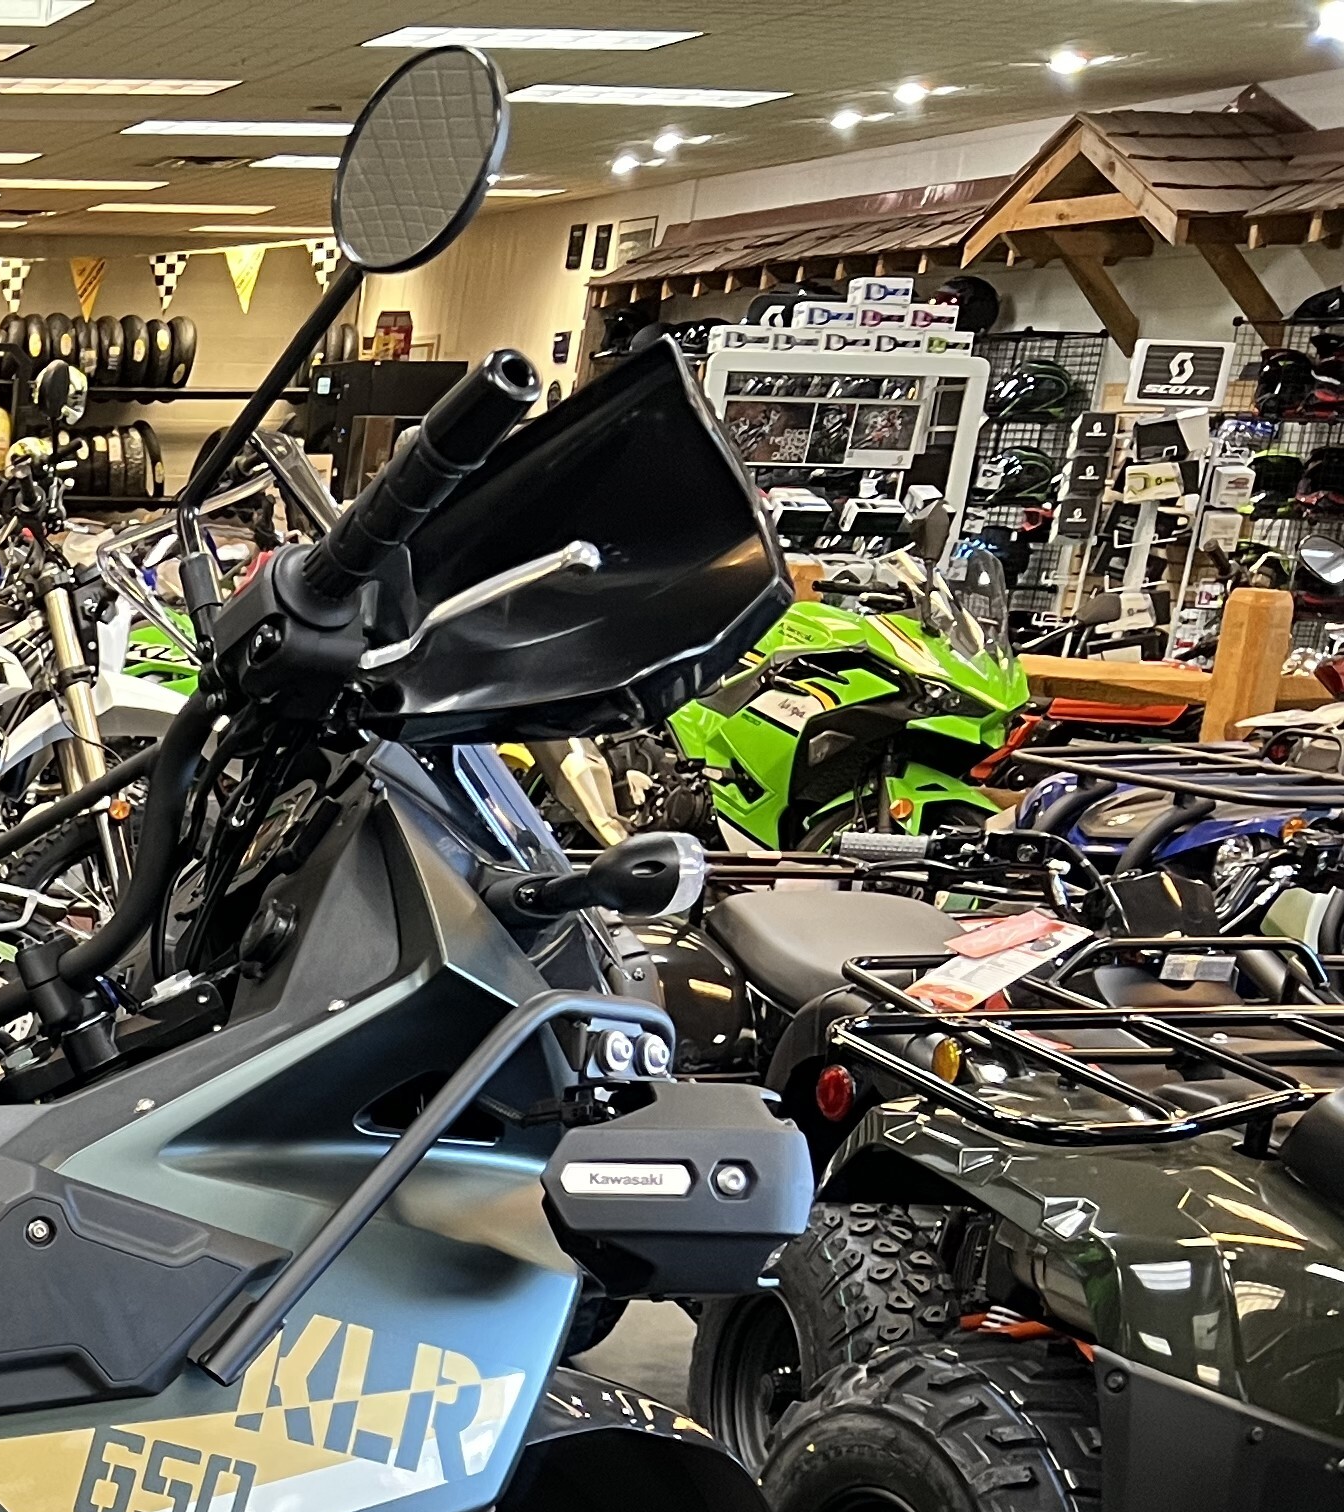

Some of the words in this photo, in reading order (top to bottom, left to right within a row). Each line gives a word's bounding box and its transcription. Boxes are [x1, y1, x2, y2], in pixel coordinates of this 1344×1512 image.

[1142, 383, 1210, 396] SCOTT
[589, 1172, 664, 1186] Kawasaki
[234, 1313, 483, 1484] KLR
